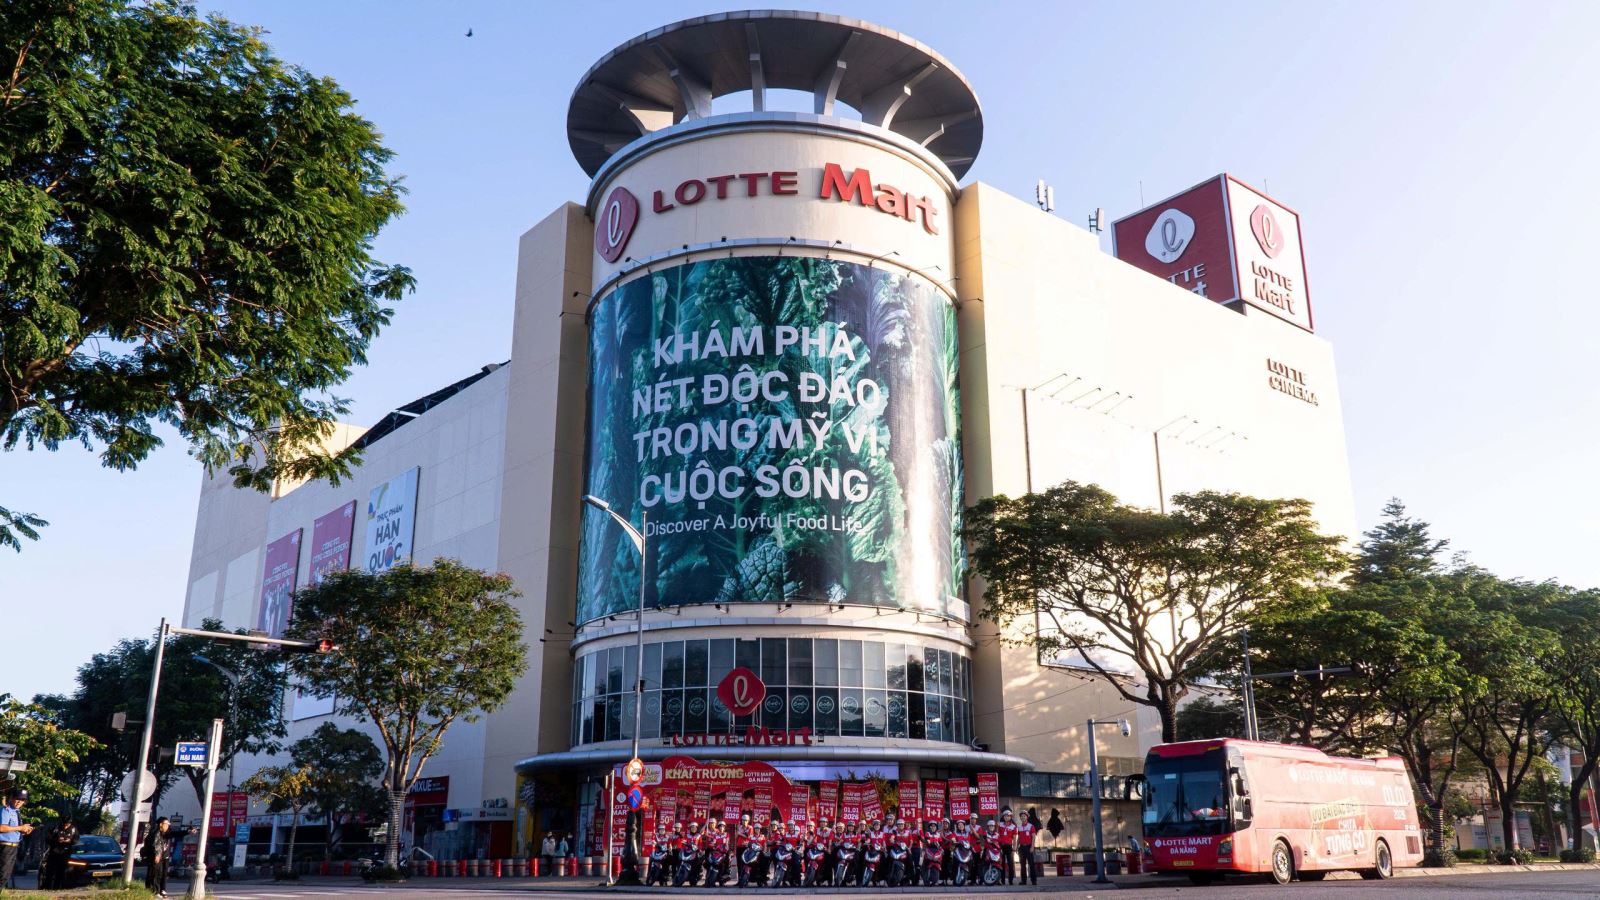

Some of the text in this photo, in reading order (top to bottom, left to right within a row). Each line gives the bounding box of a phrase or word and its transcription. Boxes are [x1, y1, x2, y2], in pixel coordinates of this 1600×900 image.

[653, 162, 939, 235] LOTTE Mart
[1167, 263, 1206, 284] TTE
[1252, 260, 1292, 292] LOTTE
[1256, 278, 1295, 315] Mart
[654, 319, 855, 368] KHÁM PHÁ
[1266, 358, 1307, 386] LOTTE
[632, 363, 880, 419] NÉT ĐỘC ĐÁO
[1269, 376, 1319, 406] CINEMA
[632, 411, 878, 467] TRONG MỸ VỊ
[640, 456, 869, 510] CUỘC SỐNG
[375, 517, 400, 546] HÀN
[646, 512, 862, 537] Discover A Joyful Food Life
[672, 726, 812, 747] LOTTE Mart
[694, 809, 707, 818] 1+1
[820, 806, 834, 816] 1+1
[901, 807, 916, 818] 1+1
[926, 808, 941, 818] 1+1
[1188, 837, 1213, 845] MART
